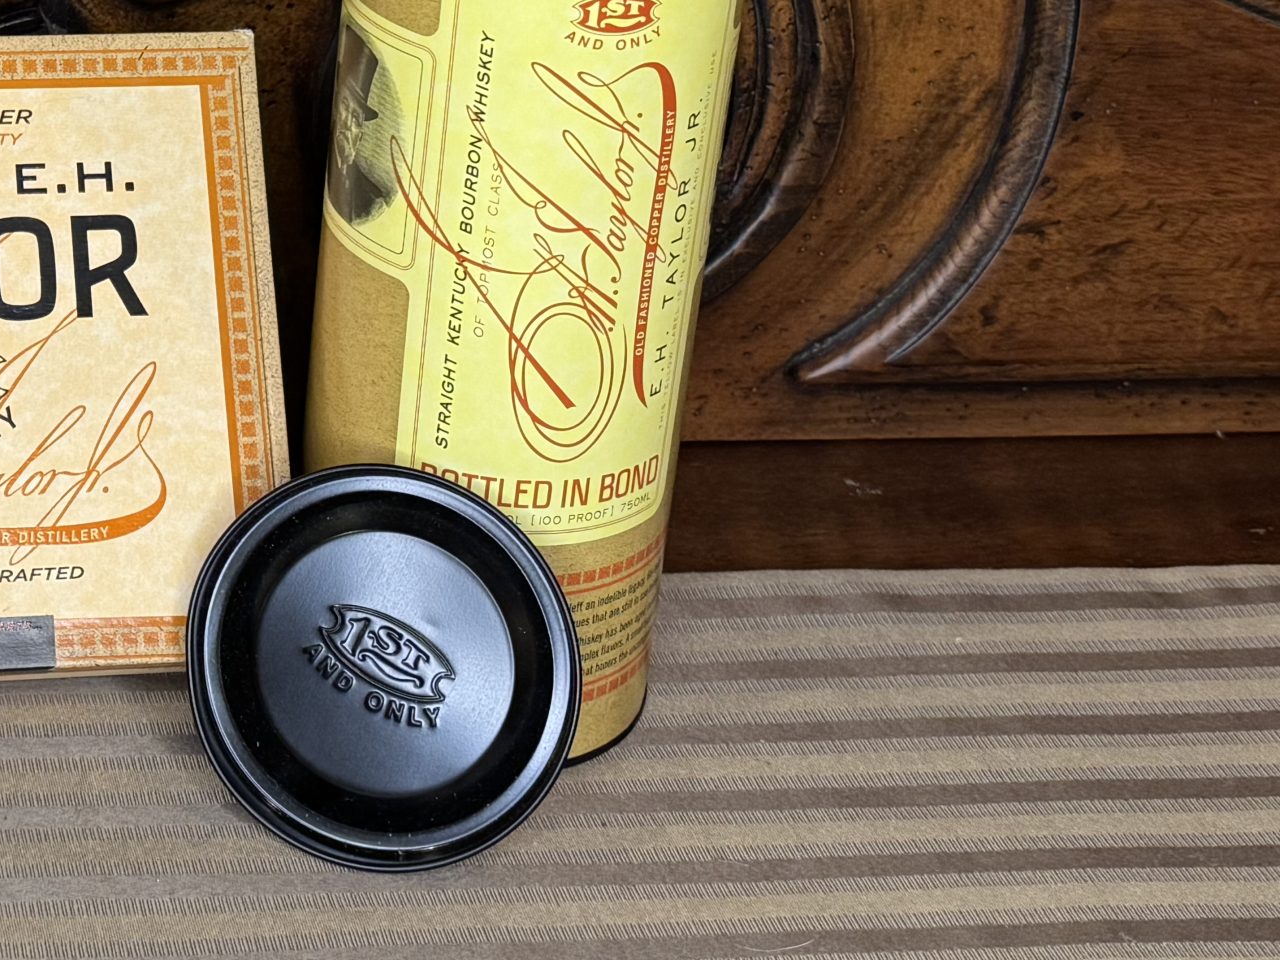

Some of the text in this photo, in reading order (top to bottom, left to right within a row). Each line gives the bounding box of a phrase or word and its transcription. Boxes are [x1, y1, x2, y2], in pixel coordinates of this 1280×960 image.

[563, 25, 663, 52] AND ONLY
[15, 160, 137, 196] E.H.
[435, 30, 496, 449] STRAIGHT KENTUCKY BOURBON WHISKEY
[473, 161, 504, 339] OF TOPMOST CLASS
[634, 109, 676, 358] OLD FASHIONED COPPER DISTILLERY
[649, 96, 703, 398] E.H. TAYLOR JR.
[560, 476, 591, 509] IN
[598, 453, 660, 504] BOND
[620, 492, 652, 514] 750ML
[18, 524, 110, 543] DISTILLERY
[338, 615, 432, 672] 1ST
[576, 631, 603, 648] hiskey
[591, 609, 608, 625] that
[302, 642, 441, 729] AND ONLY
